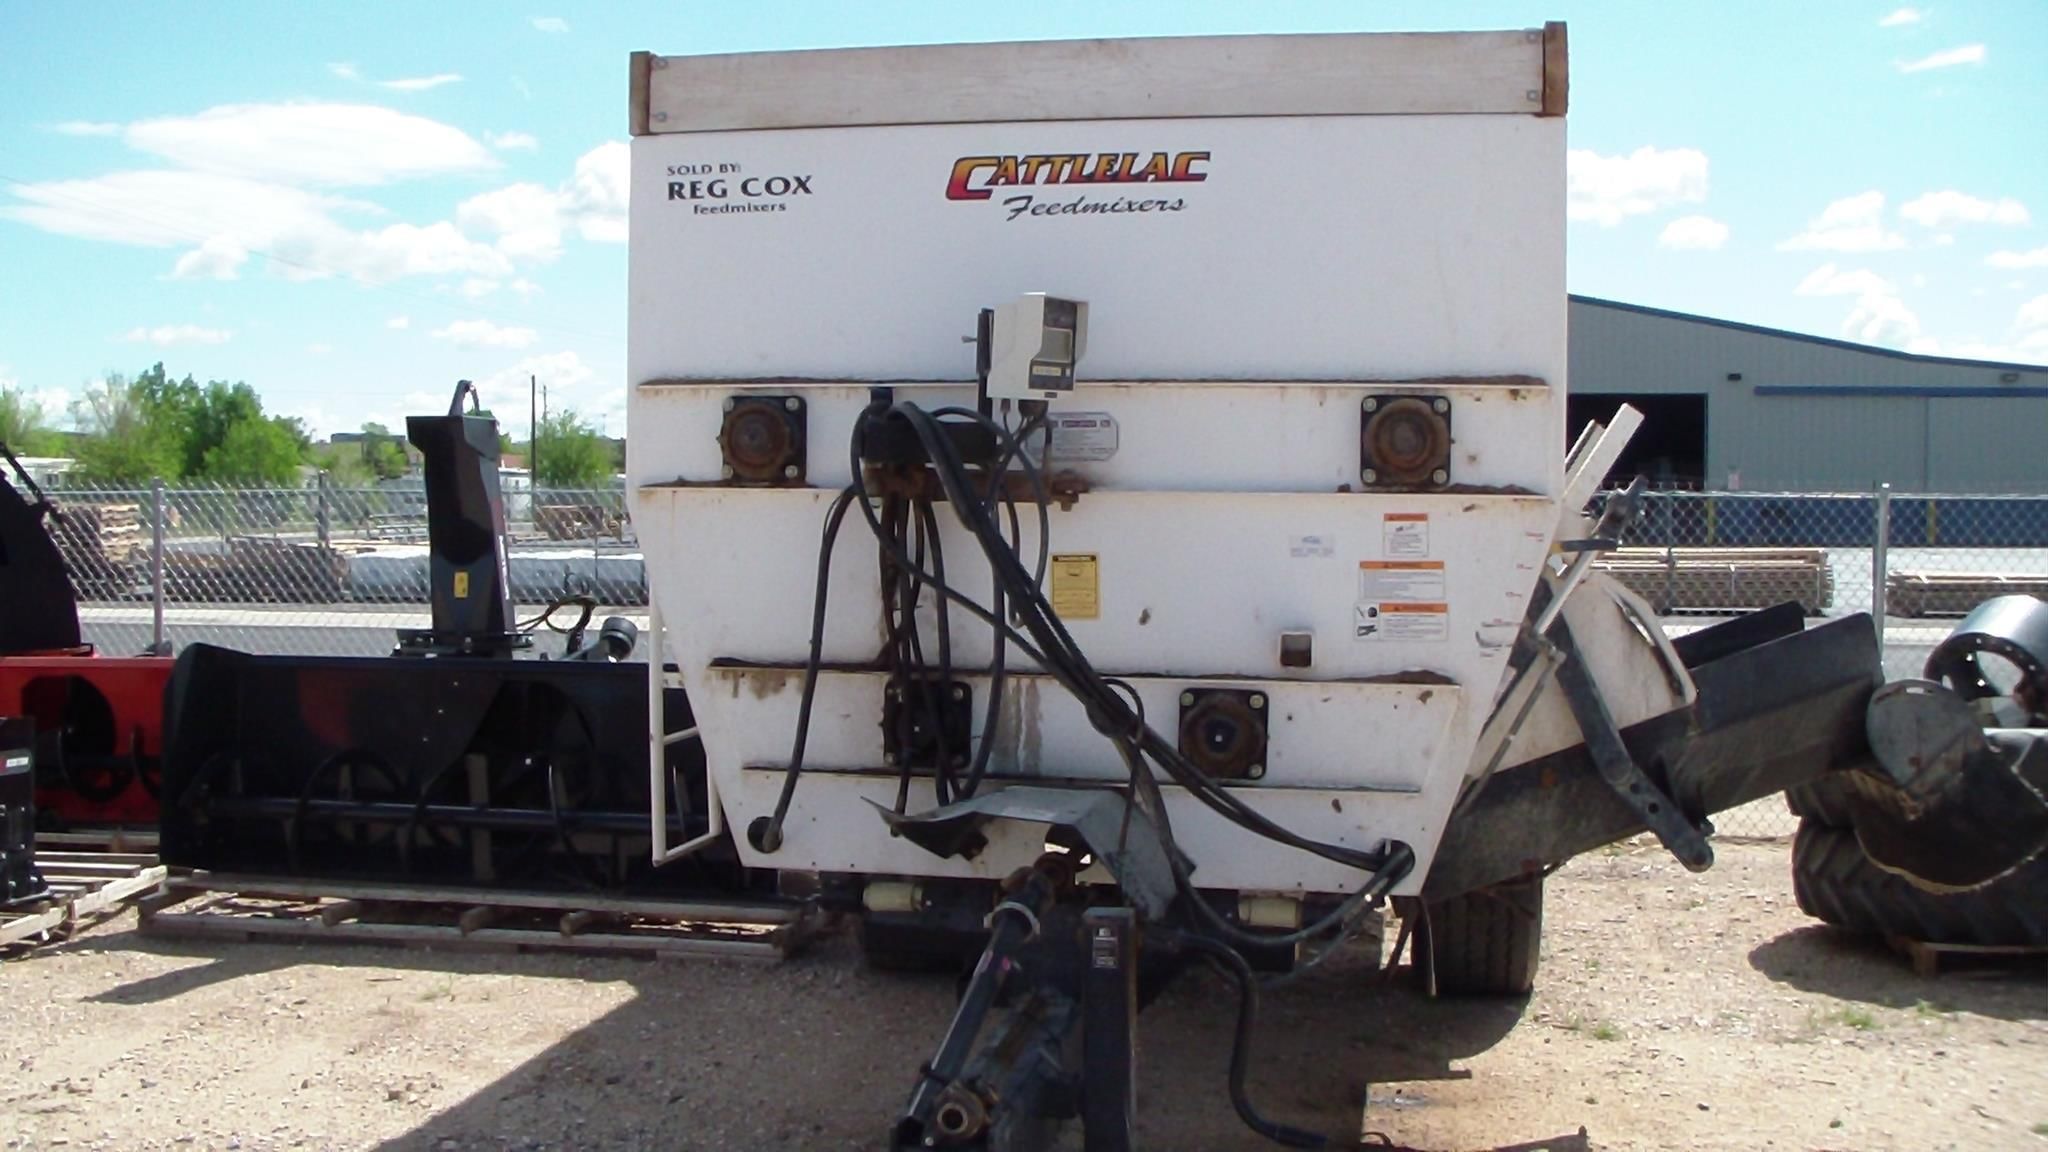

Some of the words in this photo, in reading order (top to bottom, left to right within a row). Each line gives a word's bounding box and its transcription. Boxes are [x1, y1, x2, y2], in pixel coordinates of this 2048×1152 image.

[667, 164, 712, 176] SOLD
[945, 151, 1211, 200] CATTLELAC
[668, 179, 728, 200] REG
[740, 175, 813, 197] COX
[1002, 195, 1187, 222] Feedmixers
